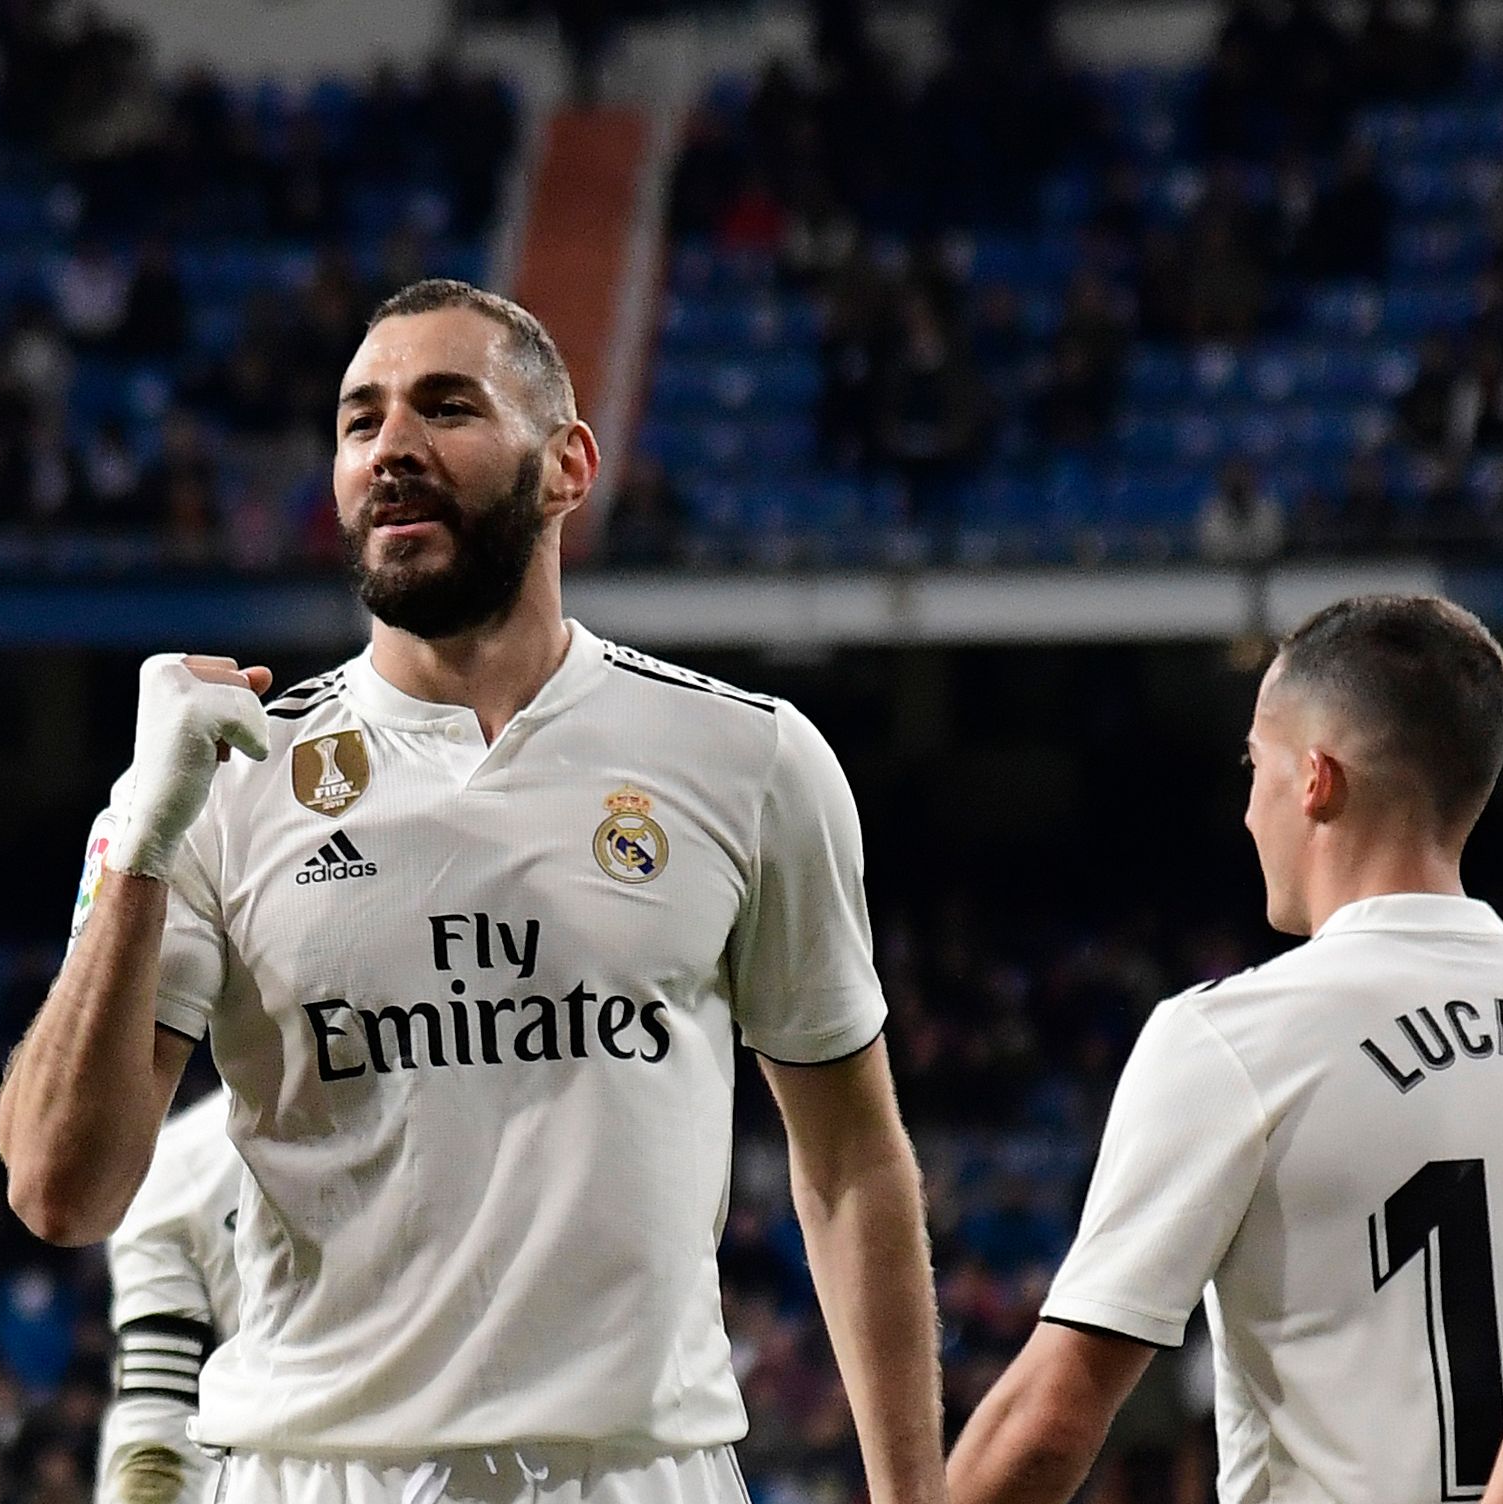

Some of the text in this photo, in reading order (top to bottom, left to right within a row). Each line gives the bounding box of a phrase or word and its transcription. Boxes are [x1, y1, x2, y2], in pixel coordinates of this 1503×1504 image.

[314, 782, 353, 799] FIFA
[296, 861, 377, 885] adidas
[428, 912, 540, 978] Fly
[301, 979, 669, 1082] Emirates
